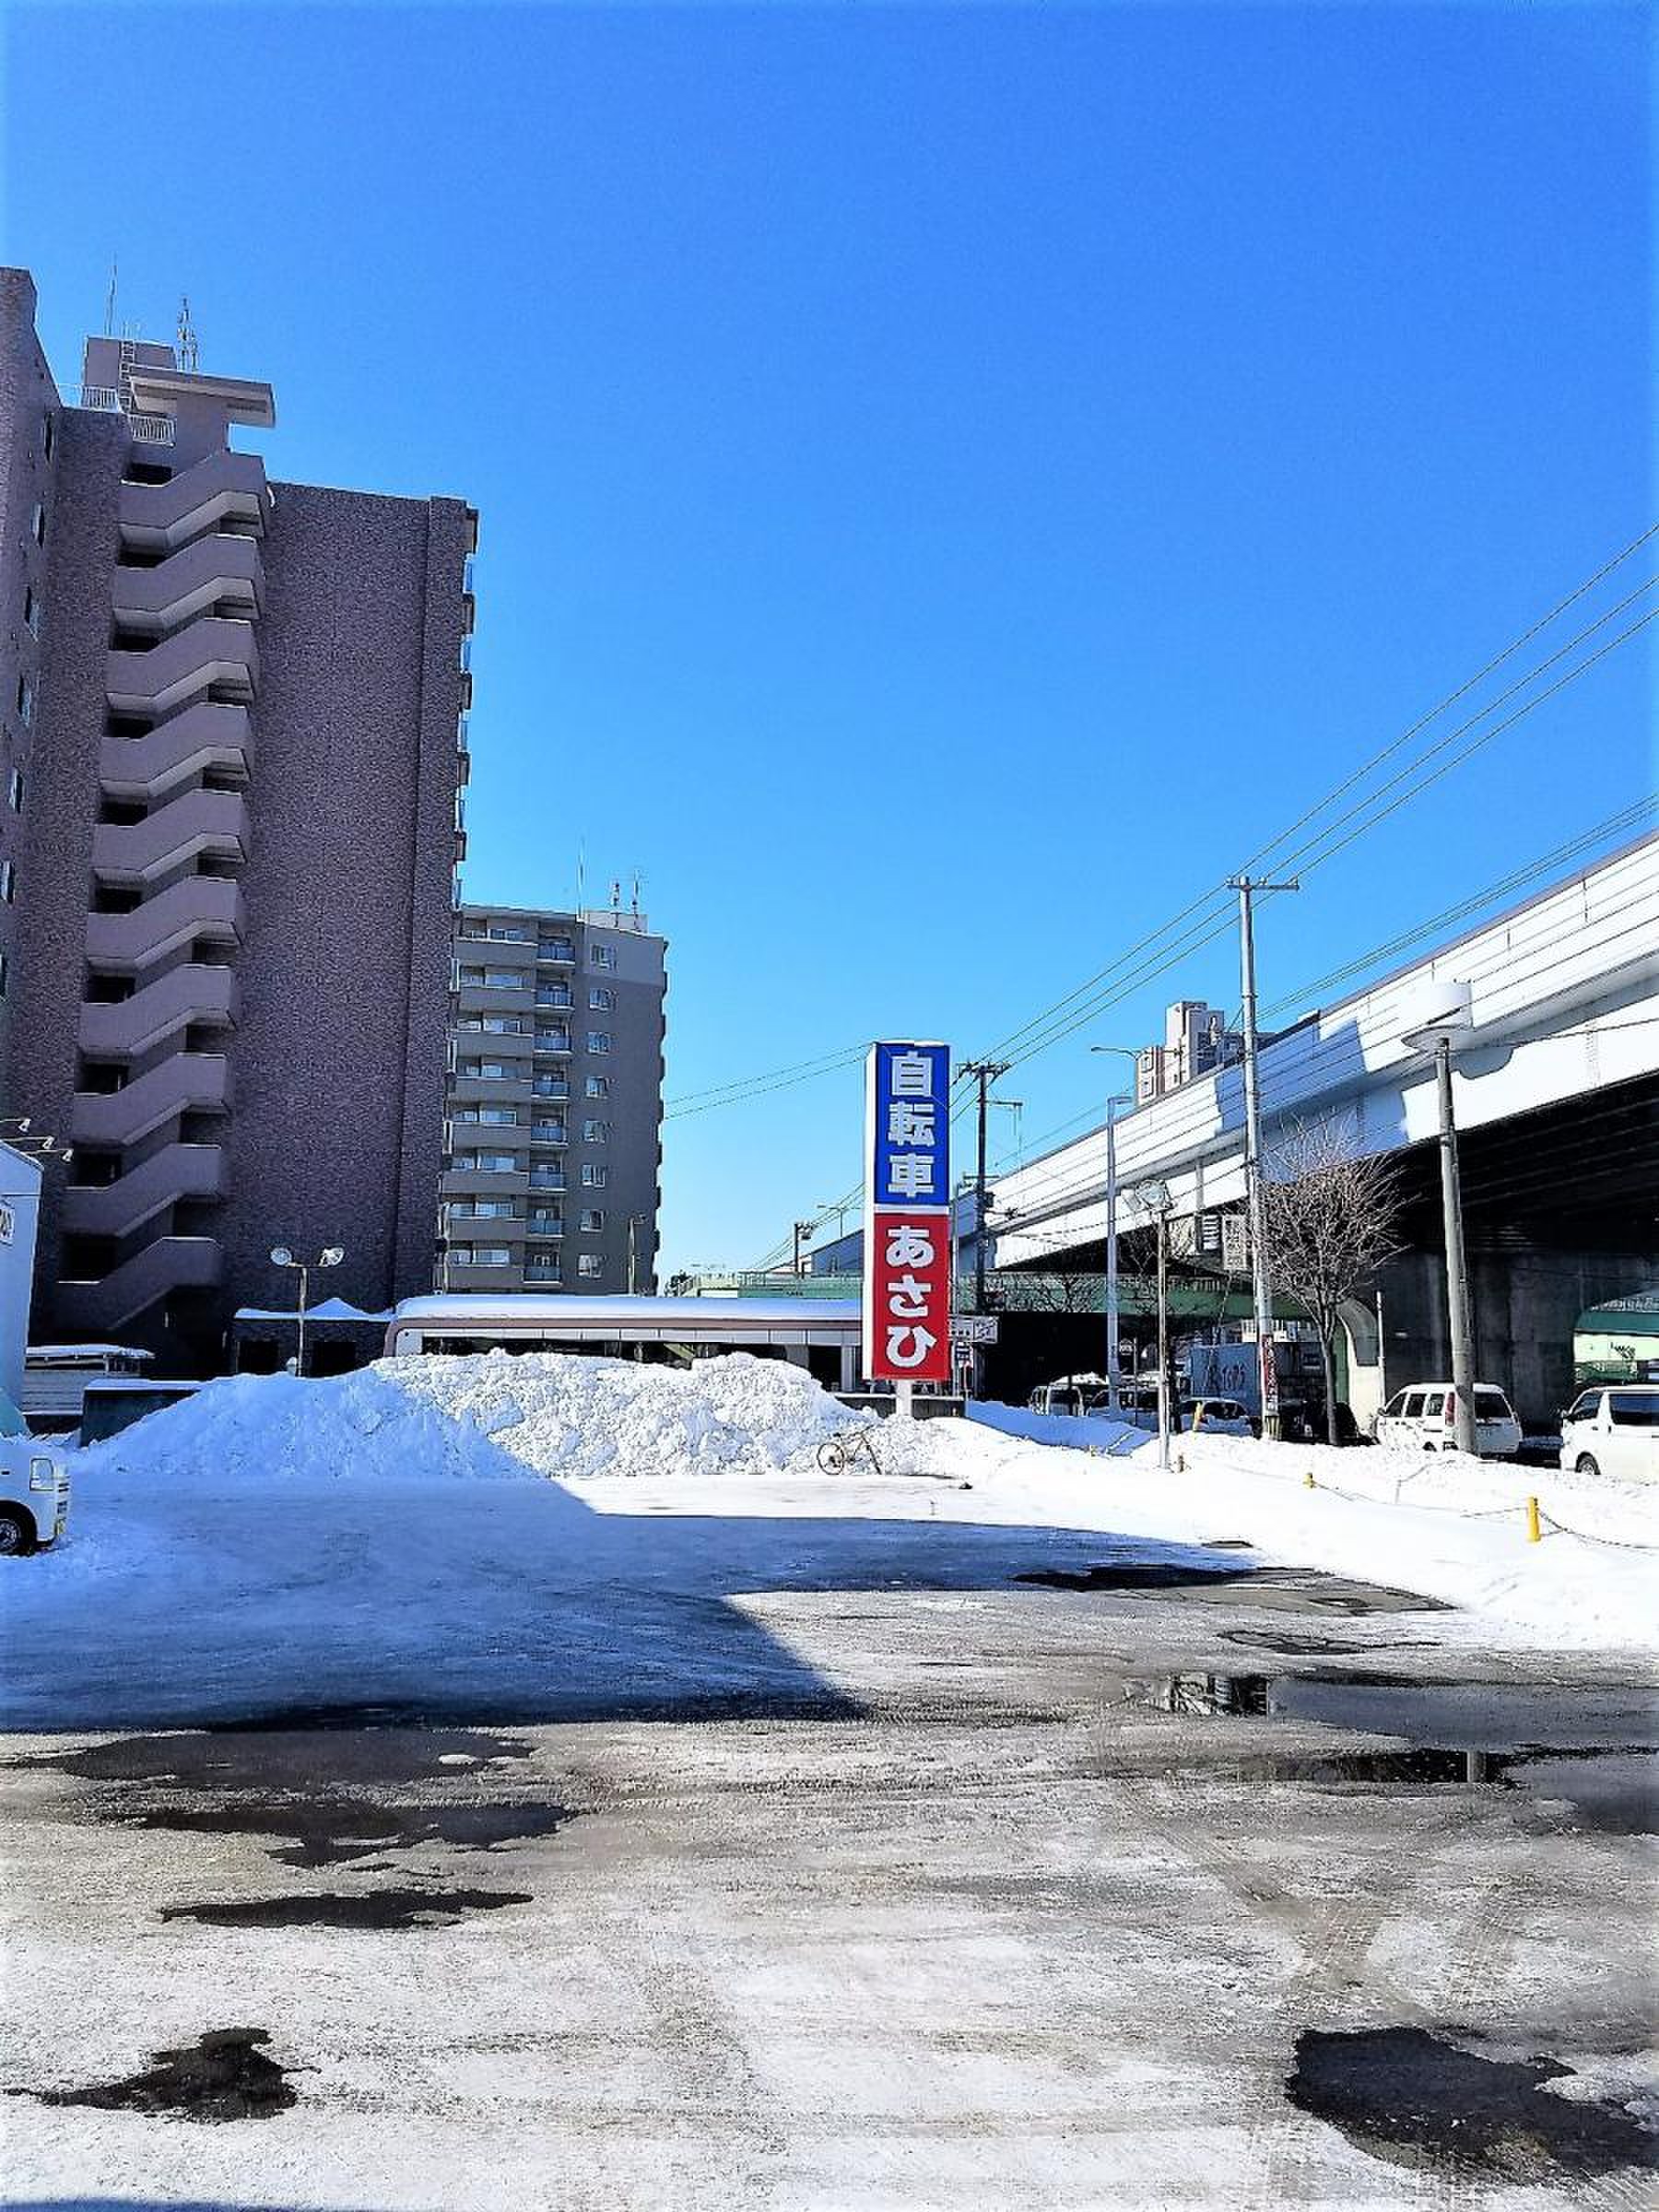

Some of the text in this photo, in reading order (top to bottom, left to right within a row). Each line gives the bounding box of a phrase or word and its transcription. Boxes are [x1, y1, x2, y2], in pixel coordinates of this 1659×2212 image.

[888, 1051, 935, 1198] 自転車
[885, 1225, 937, 1368] あさひ
